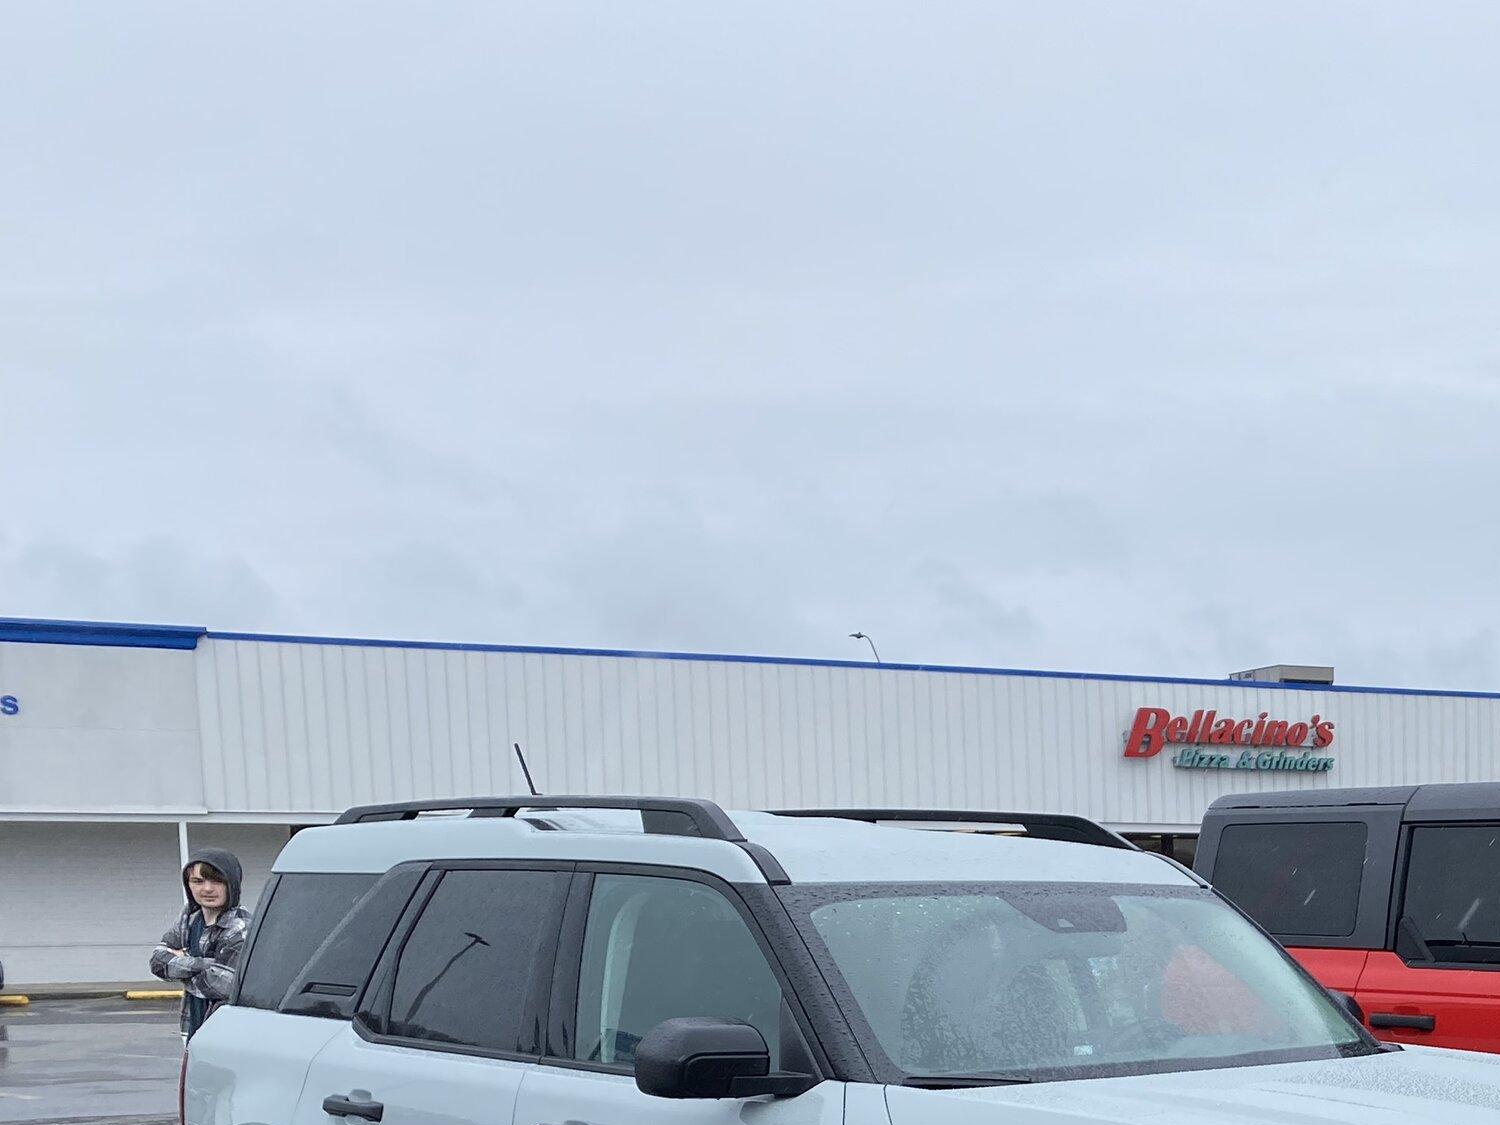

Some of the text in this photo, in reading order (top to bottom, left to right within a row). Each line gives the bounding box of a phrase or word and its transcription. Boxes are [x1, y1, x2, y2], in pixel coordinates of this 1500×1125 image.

[1124, 707, 1336, 758] Bellacino's
[1178, 749, 1336, 772] Pizza & Grinders
